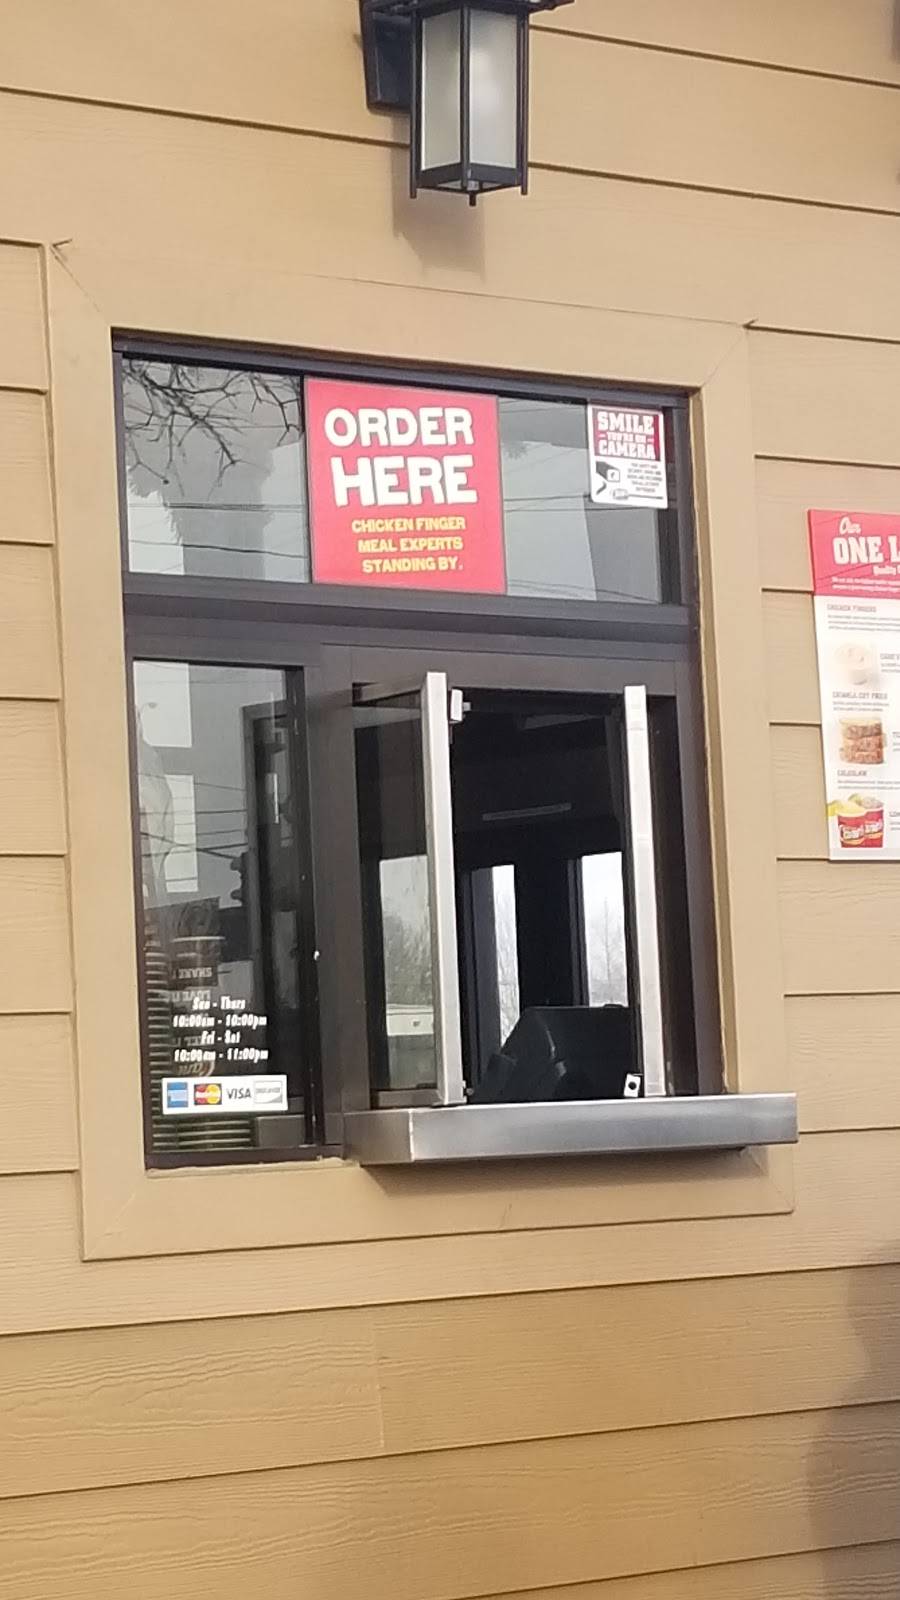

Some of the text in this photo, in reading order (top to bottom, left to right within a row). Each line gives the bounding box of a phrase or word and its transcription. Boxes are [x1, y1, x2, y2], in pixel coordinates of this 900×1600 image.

[324, 407, 474, 447] ORDER
[597, 411, 655, 435] SMILE
[598, 440, 656, 460] CAMERA
[330, 454, 478, 507] HERE
[352, 517, 466, 532] CHICKEN FINGER
[358, 537, 463, 553] MEAL EXPERTS
[833, 536, 884, 565] ONE
[362, 557, 463, 573] STANDING BY.
[192, 996, 211, 1010] Sun
[220, 996, 246, 1010] Thurs
[173, 1014, 215, 1028] 10:00am
[225, 1013, 268, 1030] 10:00pm
[201, 1031, 216, 1045] Fri
[224, 1030, 241, 1044] Sat
[174, 1049, 216, 1063] 10:00am
[227, 1048, 269, 1064] 11:00pm
[226, 1087, 252, 1100] VISA
